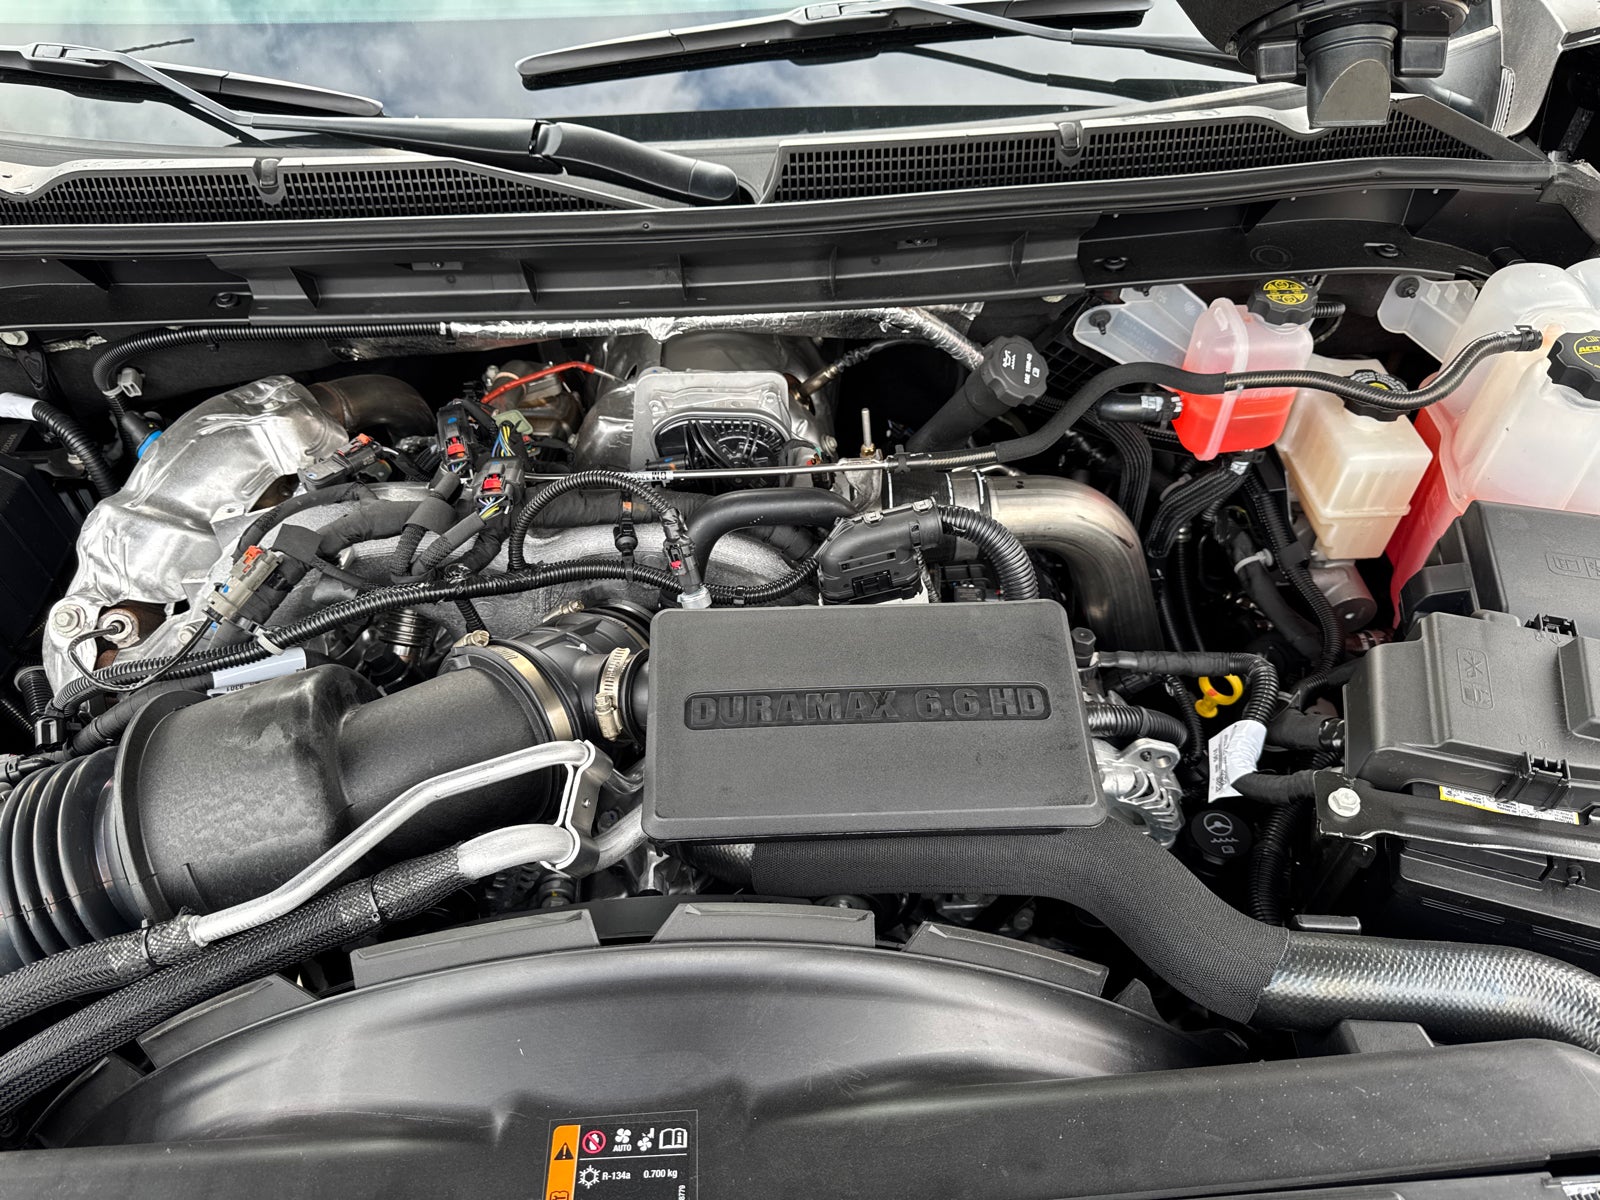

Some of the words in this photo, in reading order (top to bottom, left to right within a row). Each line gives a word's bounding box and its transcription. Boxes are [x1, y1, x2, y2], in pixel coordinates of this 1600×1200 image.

[690, 690, 899, 727] DURAMAX
[914, 687, 980, 719] 6.6
[988, 687, 1045, 718] HD
[612, 1144, 632, 1152] AUTO
[602, 1171, 631, 1180] R-134a
[643, 1169, 666, 1179] 0.700
[667, 1169, 678, 1179] kg
